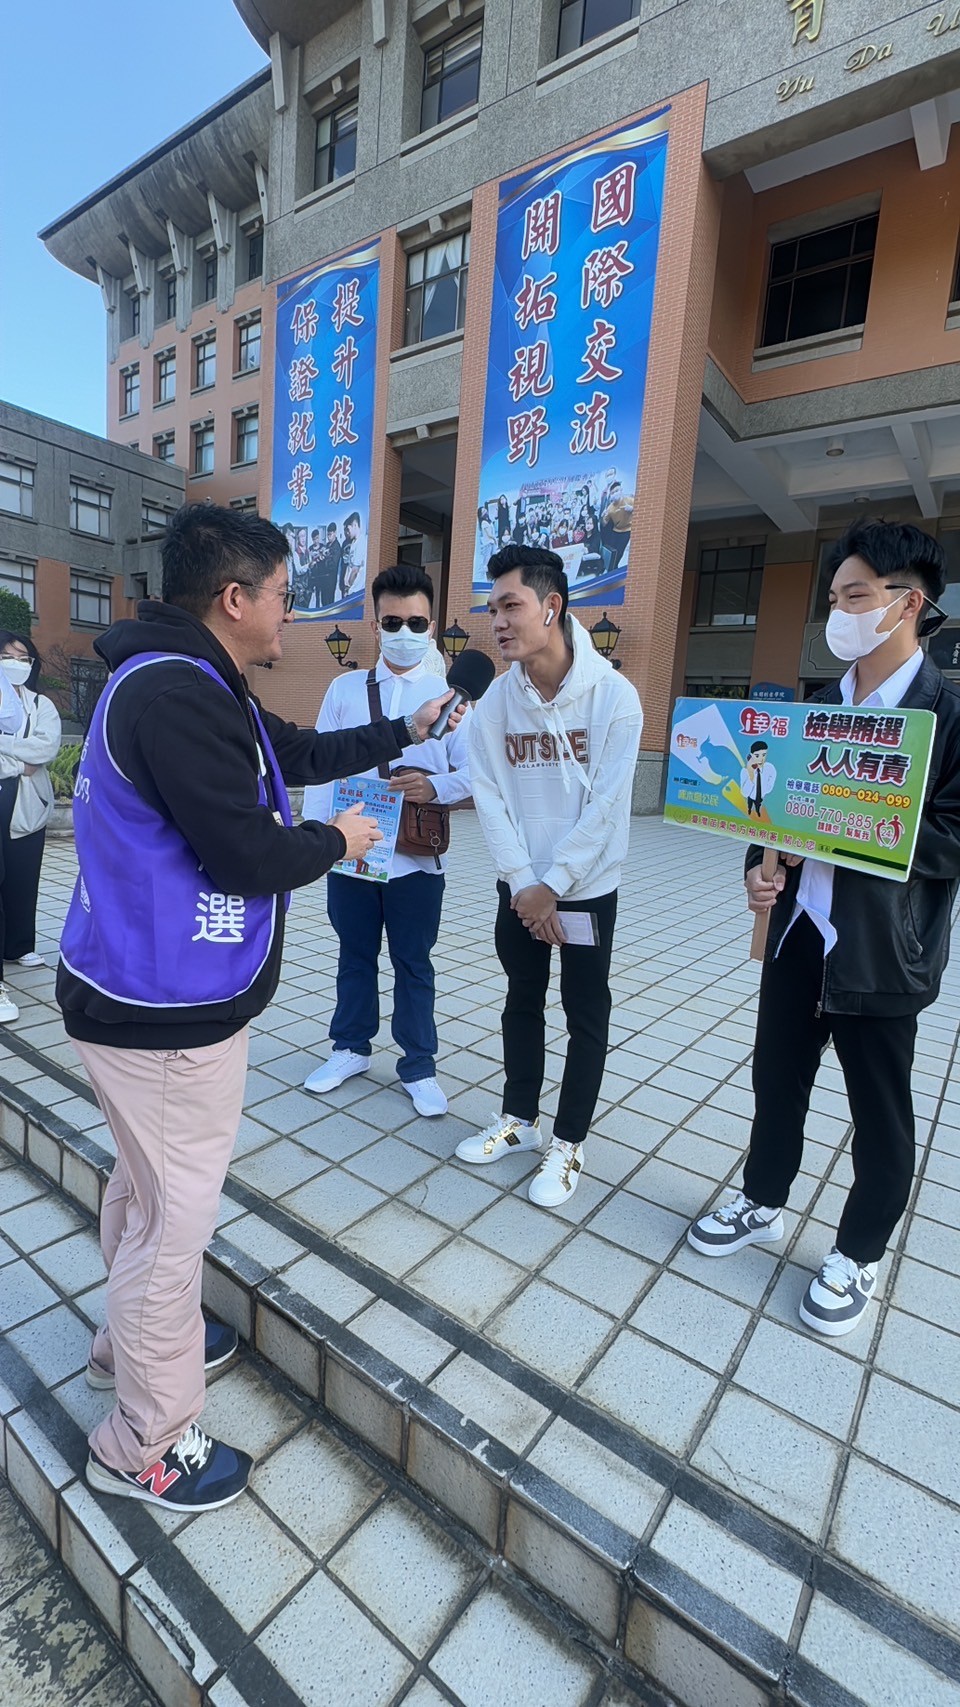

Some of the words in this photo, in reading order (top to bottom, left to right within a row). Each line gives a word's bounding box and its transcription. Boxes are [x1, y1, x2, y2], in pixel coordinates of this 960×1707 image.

[775, 73, 816, 102] Yu
[843, 41, 894, 73] Da
[506, 190, 562, 468] 開拓視野
[567, 160, 638, 456] 國際交流
[287, 299, 319, 512] 保證就業
[328, 276, 365, 504] 提升技能
[803, 710, 906, 748] 檢舉賄選
[808, 746, 911, 787] 人人有責
[785, 801, 873, 829] 0800-770-885
[786, 779, 821, 794] 檢舉電話
[821, 783, 911, 808] 0800-024-099
[192, 891, 246, 943] 選
[136, 1460, 181, 1496] N
